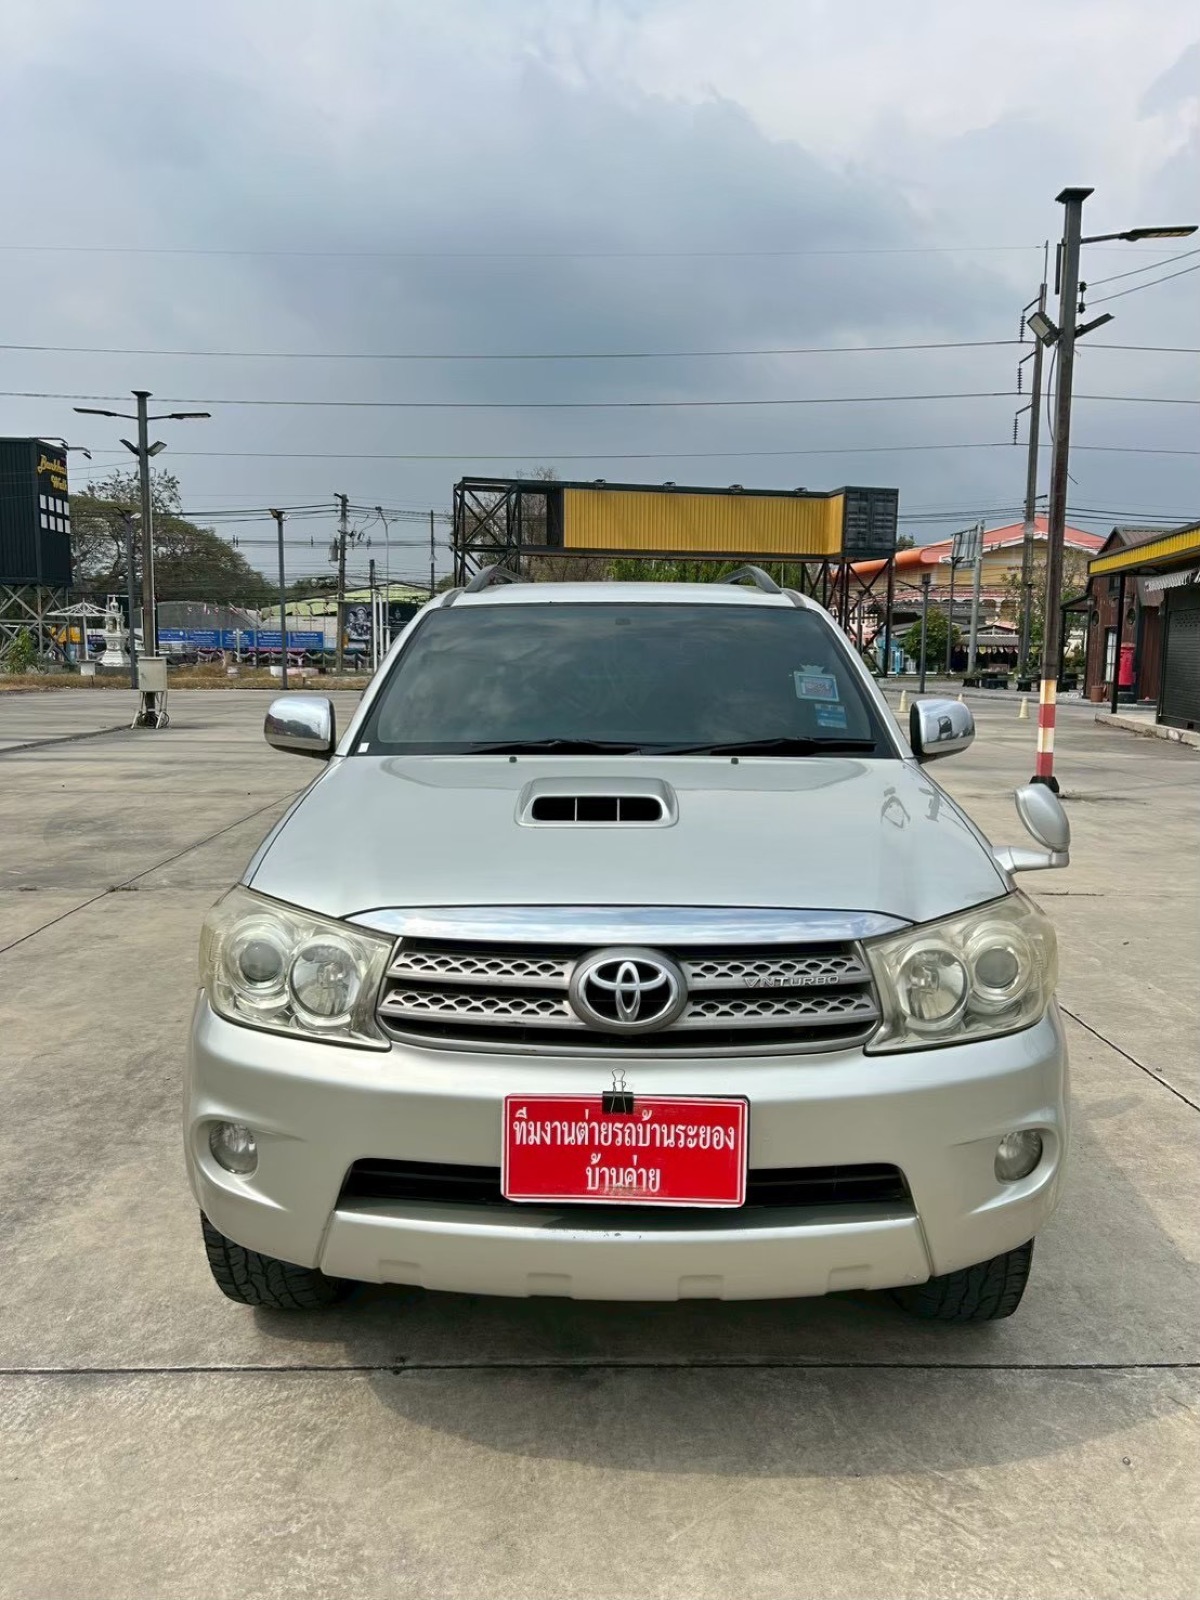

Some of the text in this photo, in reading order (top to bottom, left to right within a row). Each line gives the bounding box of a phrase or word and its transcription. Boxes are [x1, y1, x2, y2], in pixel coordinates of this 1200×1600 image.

[512, 1107, 736, 1150] ทีมงานต่ายรถบ้านระยอง
[585, 1153, 661, 1193] บ้านค่าย
